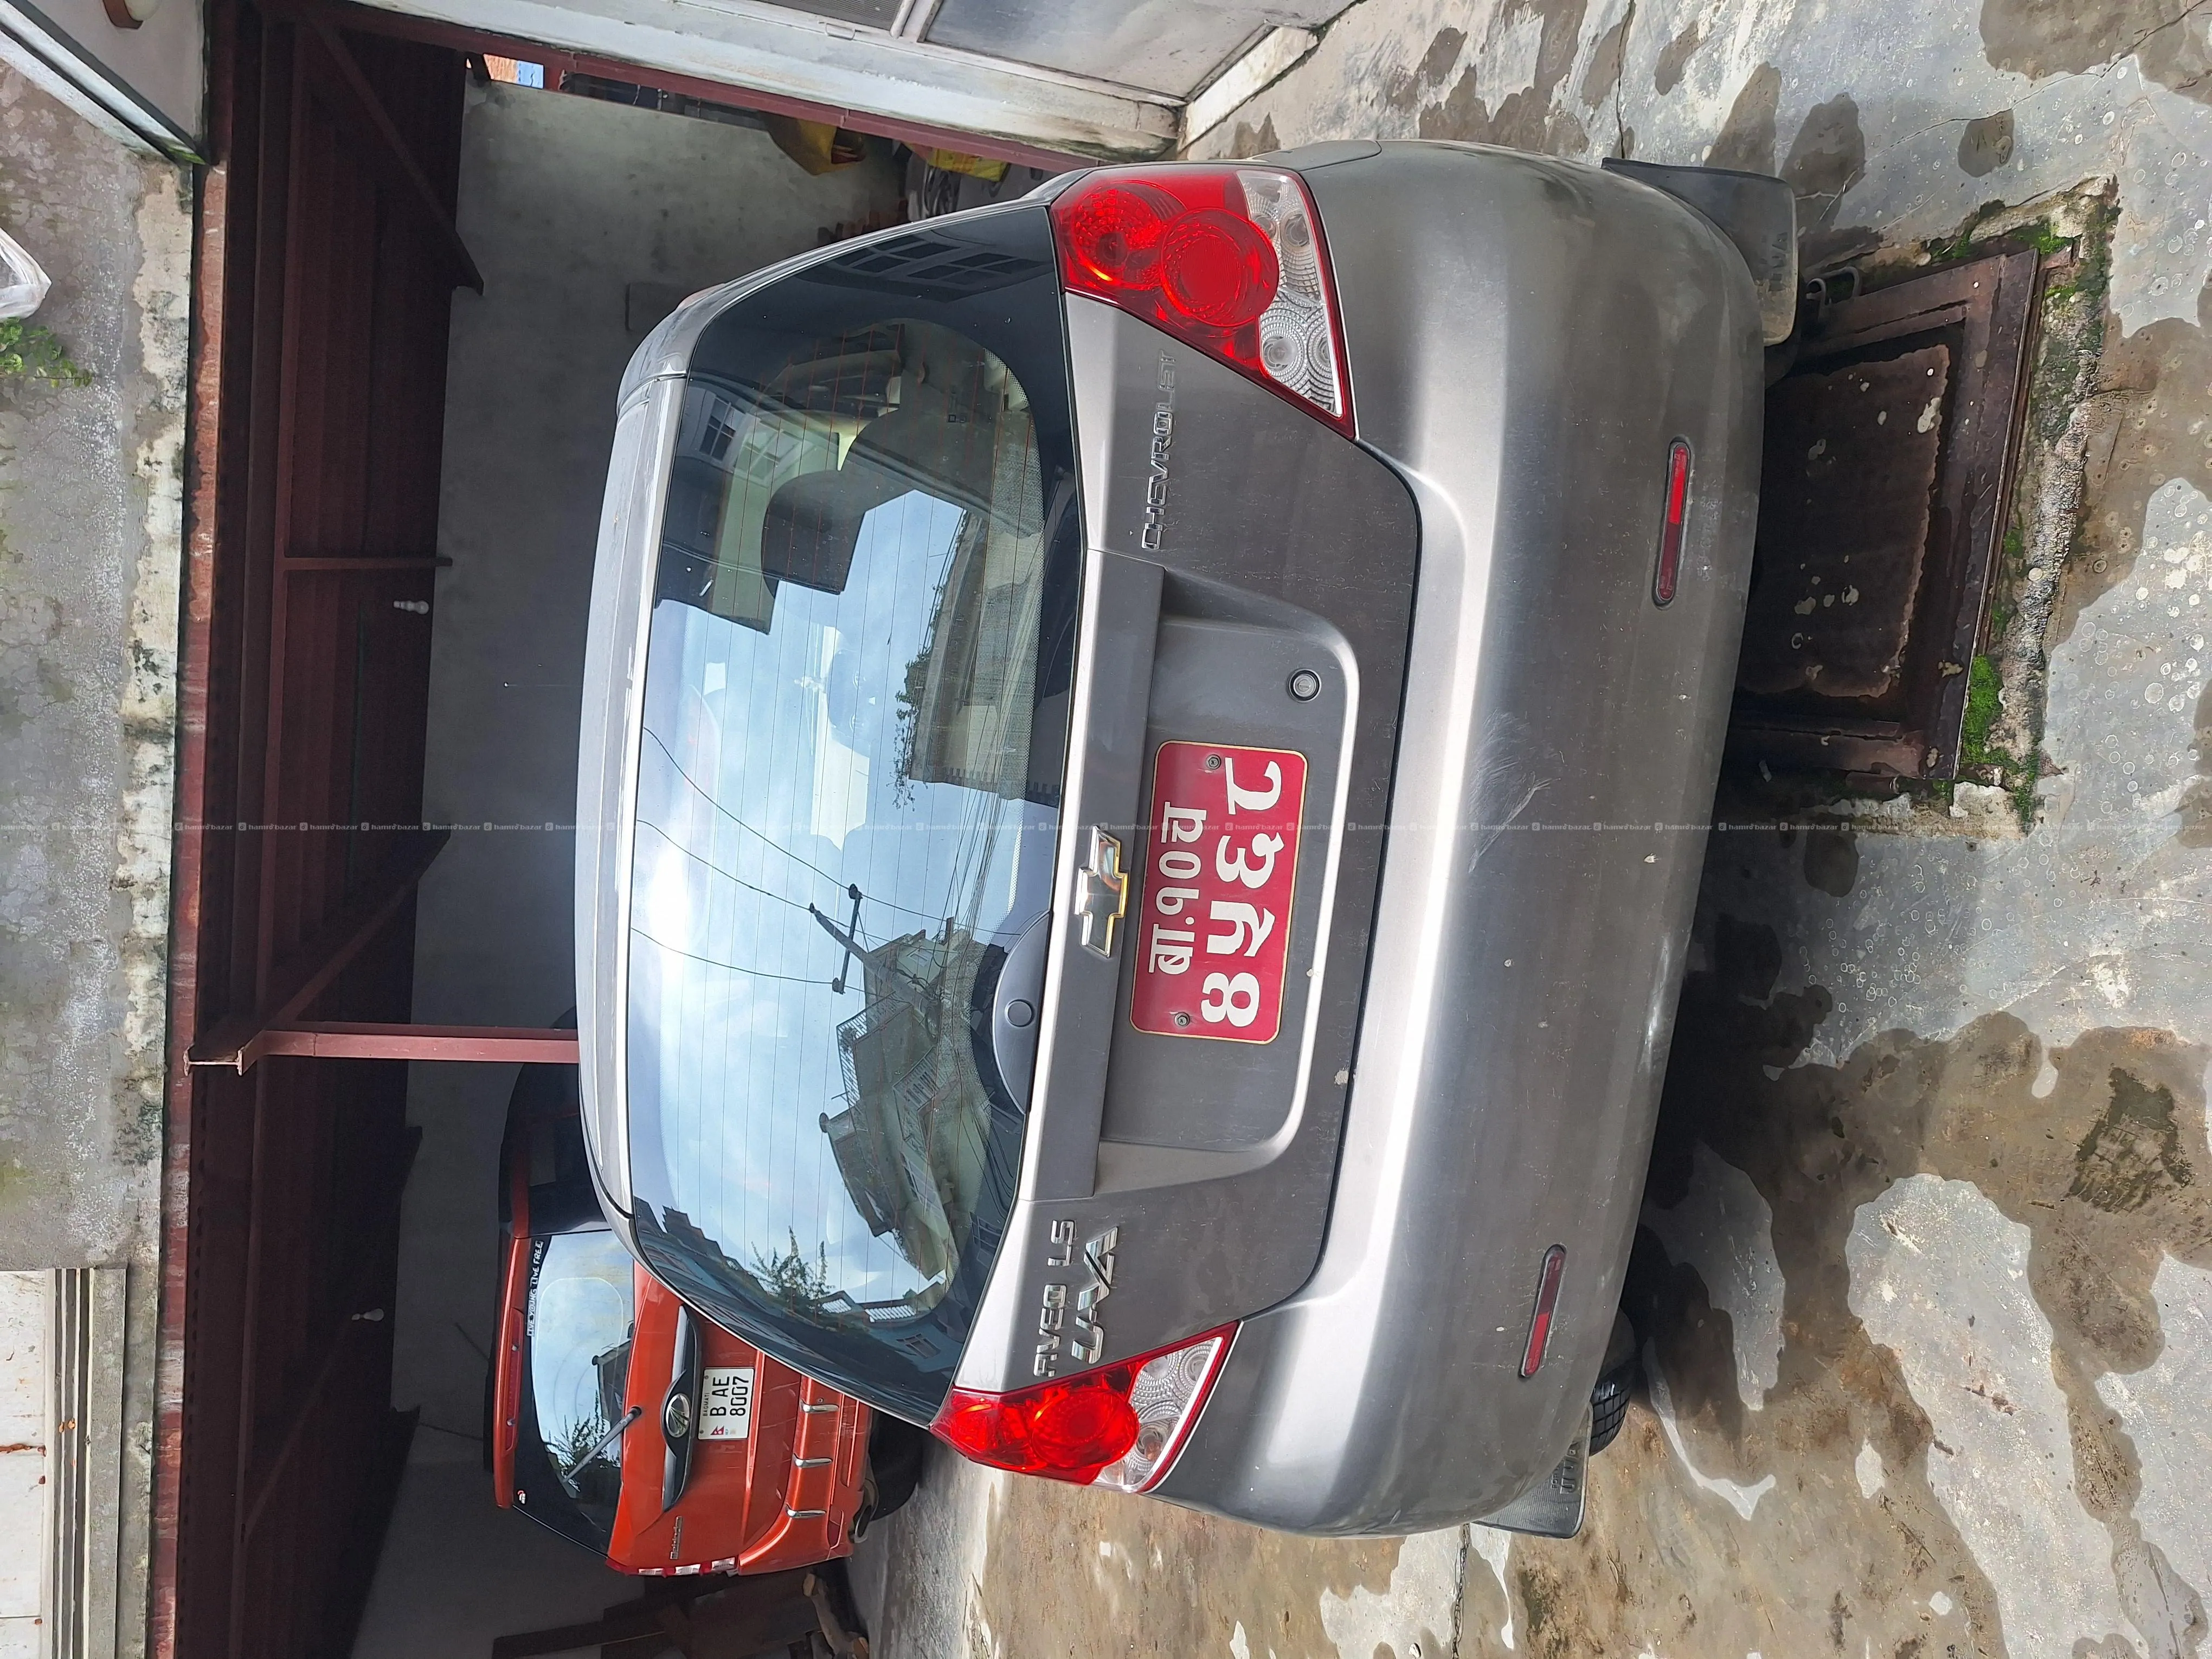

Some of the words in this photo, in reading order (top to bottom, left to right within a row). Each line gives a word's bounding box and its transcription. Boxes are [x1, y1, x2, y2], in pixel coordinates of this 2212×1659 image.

[1141, 349, 1176, 550] CHEVROLET
[1200, 757, 1284, 1027] ४५६८
[533, 1240, 544, 1264] FREE
[1047, 1219, 1075, 1266] LS
[1033, 1284, 1067, 1378] AVEO
[712, 1376, 730, 1398] AE
[729, 1376, 749, 1416] 8007
[710, 1407, 726, 1416] B
